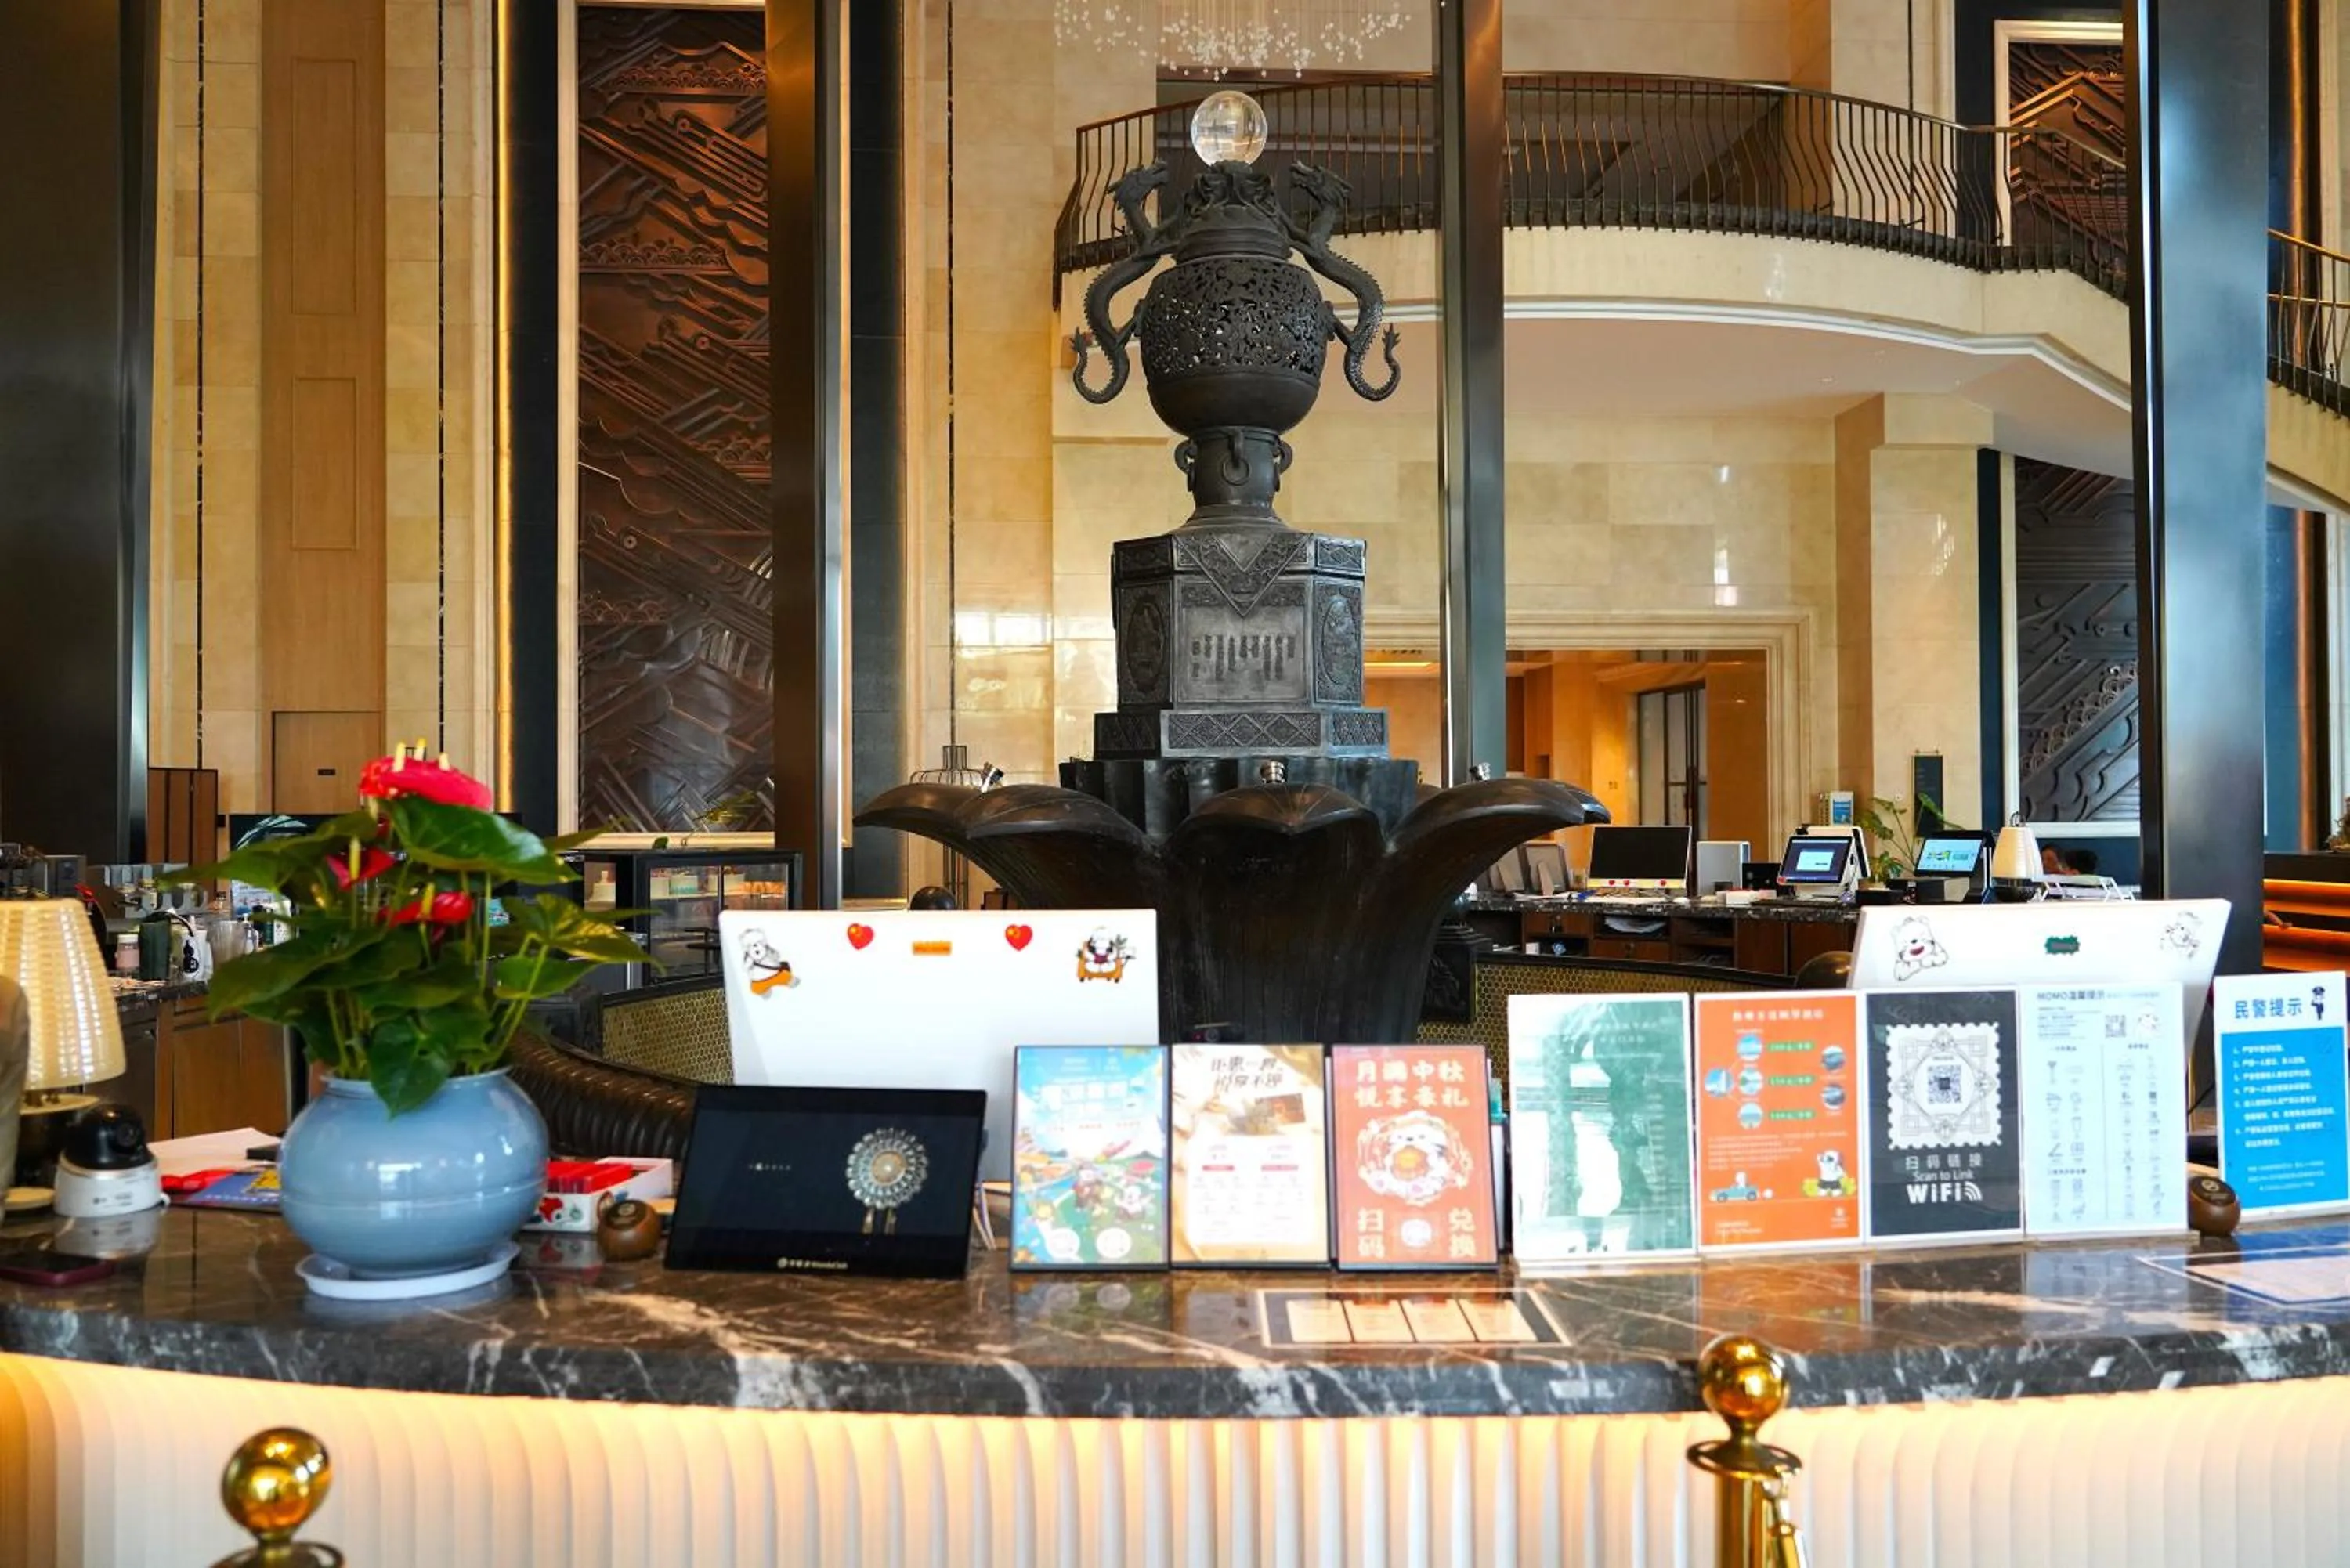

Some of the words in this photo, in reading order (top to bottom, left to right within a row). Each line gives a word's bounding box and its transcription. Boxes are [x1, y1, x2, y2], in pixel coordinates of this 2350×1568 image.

[2235, 997, 2303, 1019] 民警提示
[1913, 1172, 1937, 1182] Scan
[1940, 1171, 1951, 1181] to
